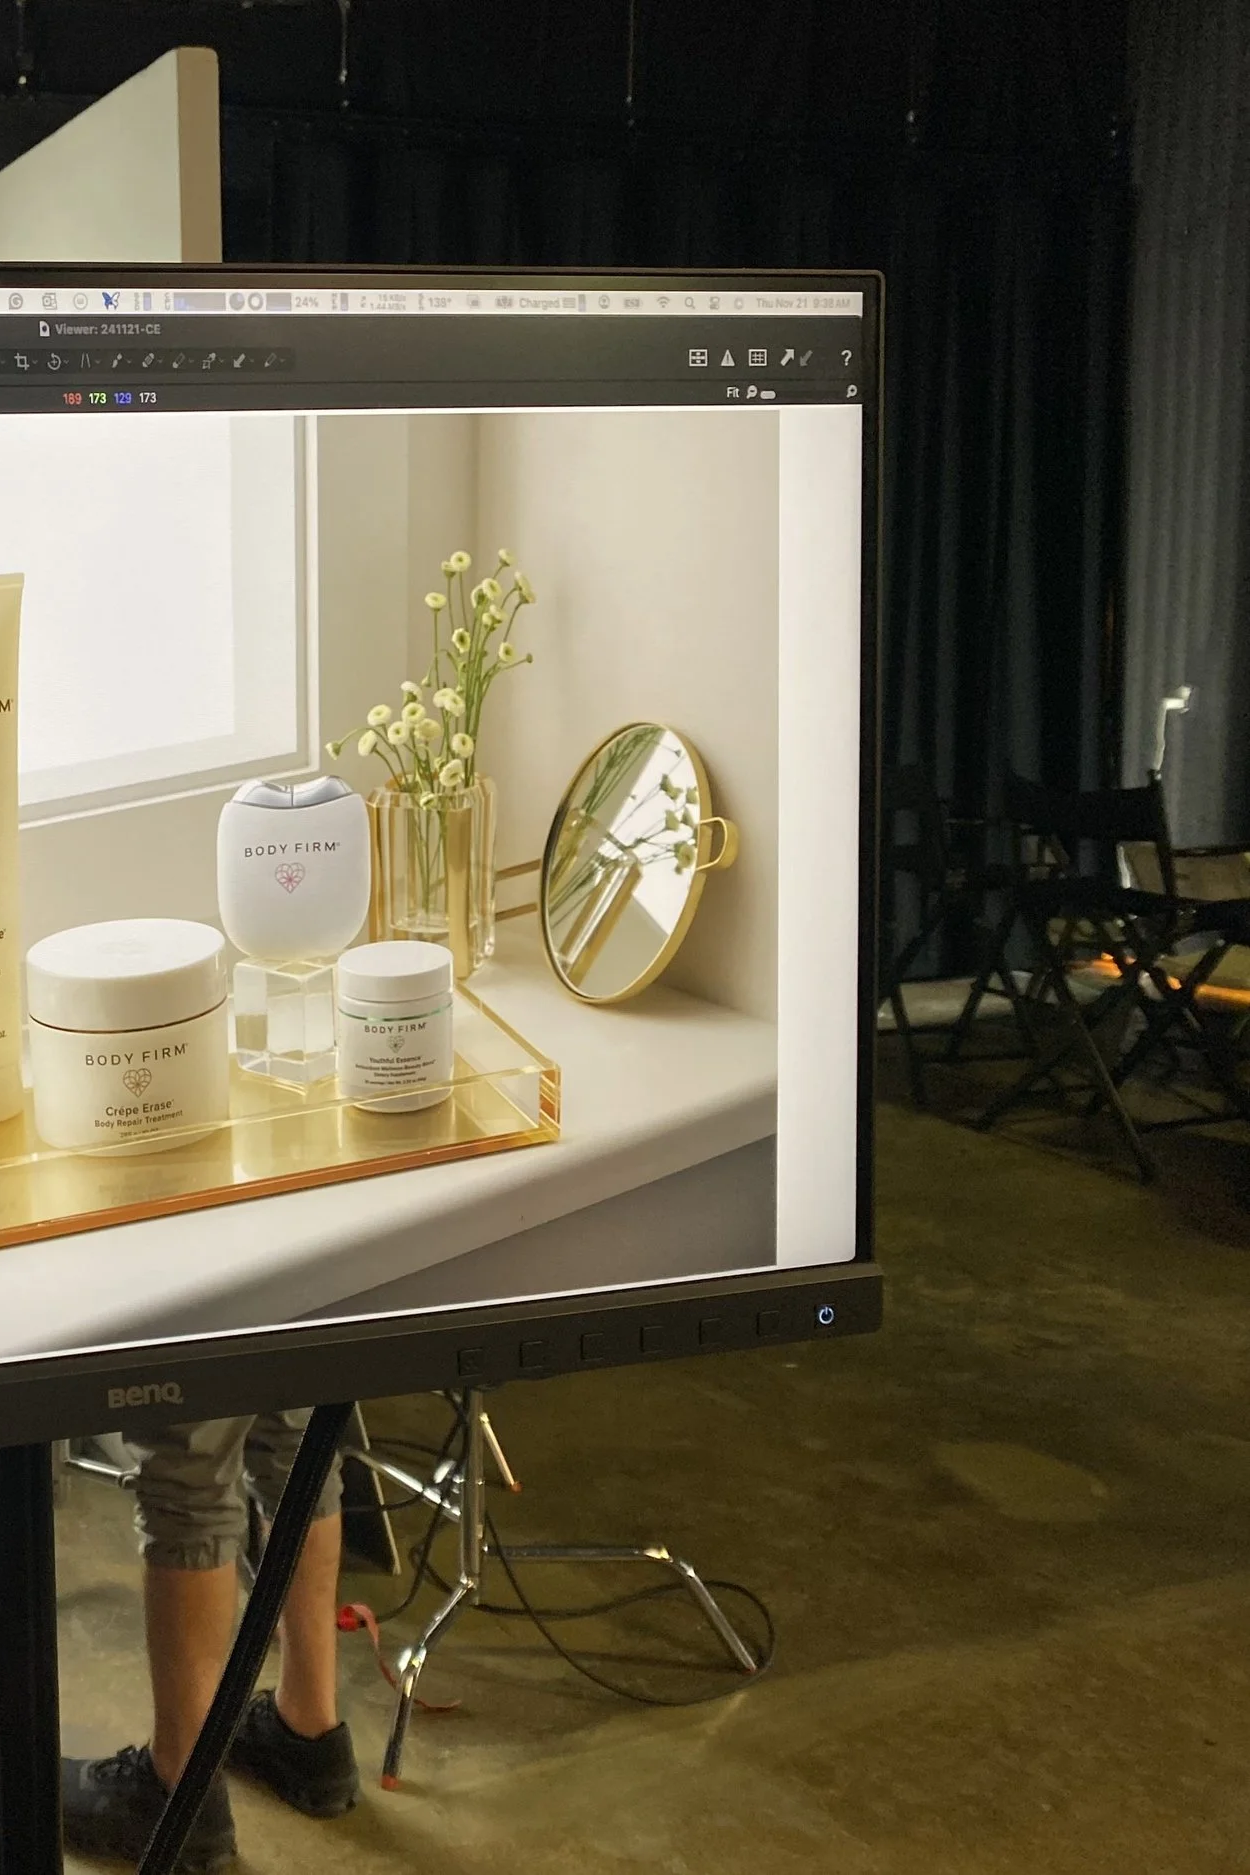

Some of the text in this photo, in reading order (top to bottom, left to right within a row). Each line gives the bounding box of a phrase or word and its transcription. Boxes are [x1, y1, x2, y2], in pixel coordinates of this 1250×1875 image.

[519, 296, 560, 310] Charged
[756, 298, 774, 309] Thu
[775, 298, 793, 309] Nov
[796, 298, 808, 309] 21
[55, 323, 161, 335] Viewer: 241121-CE
[89, 392, 107, 404] 173
[114, 392, 132, 404] 129
[139, 392, 157, 403] 173
[726, 386, 740, 398] Fit
[244, 844, 288, 857] BODY
[364, 1025, 394, 1034] BODY
[85, 1053, 134, 1066] BODY
[94, 1110, 183, 1129] Body Repair Treatment
[107, 1381, 184, 1409] BenQ
